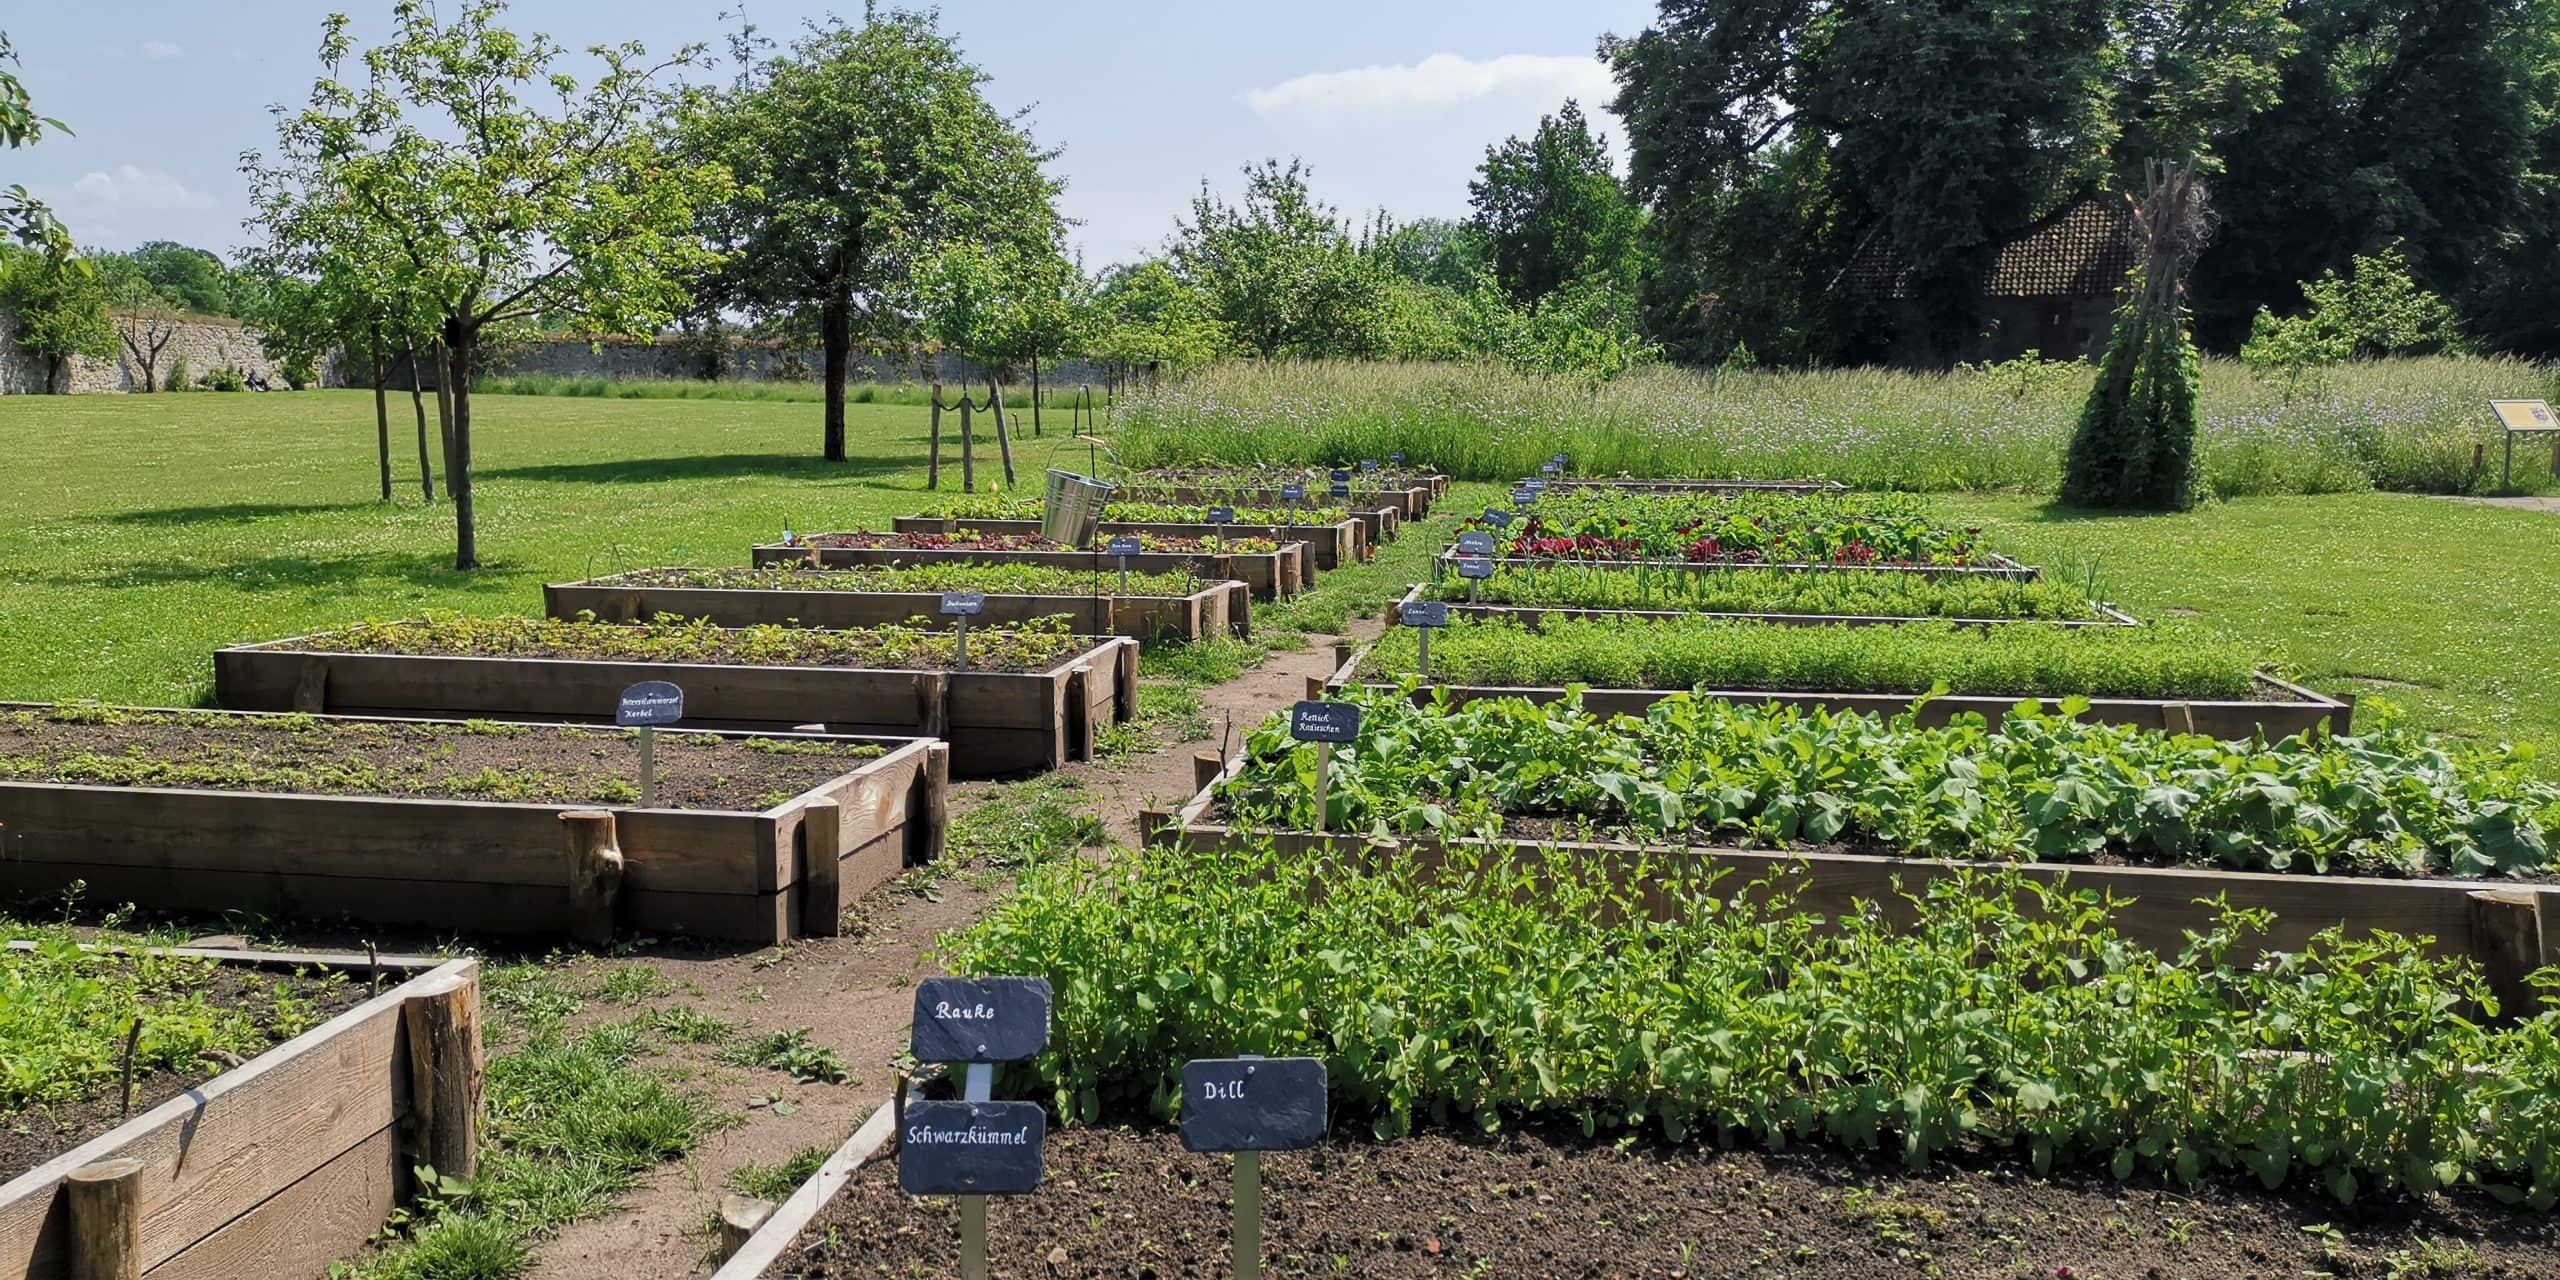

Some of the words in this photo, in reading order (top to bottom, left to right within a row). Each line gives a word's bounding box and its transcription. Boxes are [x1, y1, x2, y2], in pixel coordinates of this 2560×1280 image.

[1300, 711, 1330, 723] Rettich
[1298, 722, 1341, 734] Radieschen
[935, 1001, 995, 1021] Rauke
[1202, 1079, 1246, 1101] Dill
[905, 1125, 1029, 1147] Schwarzkümmel
